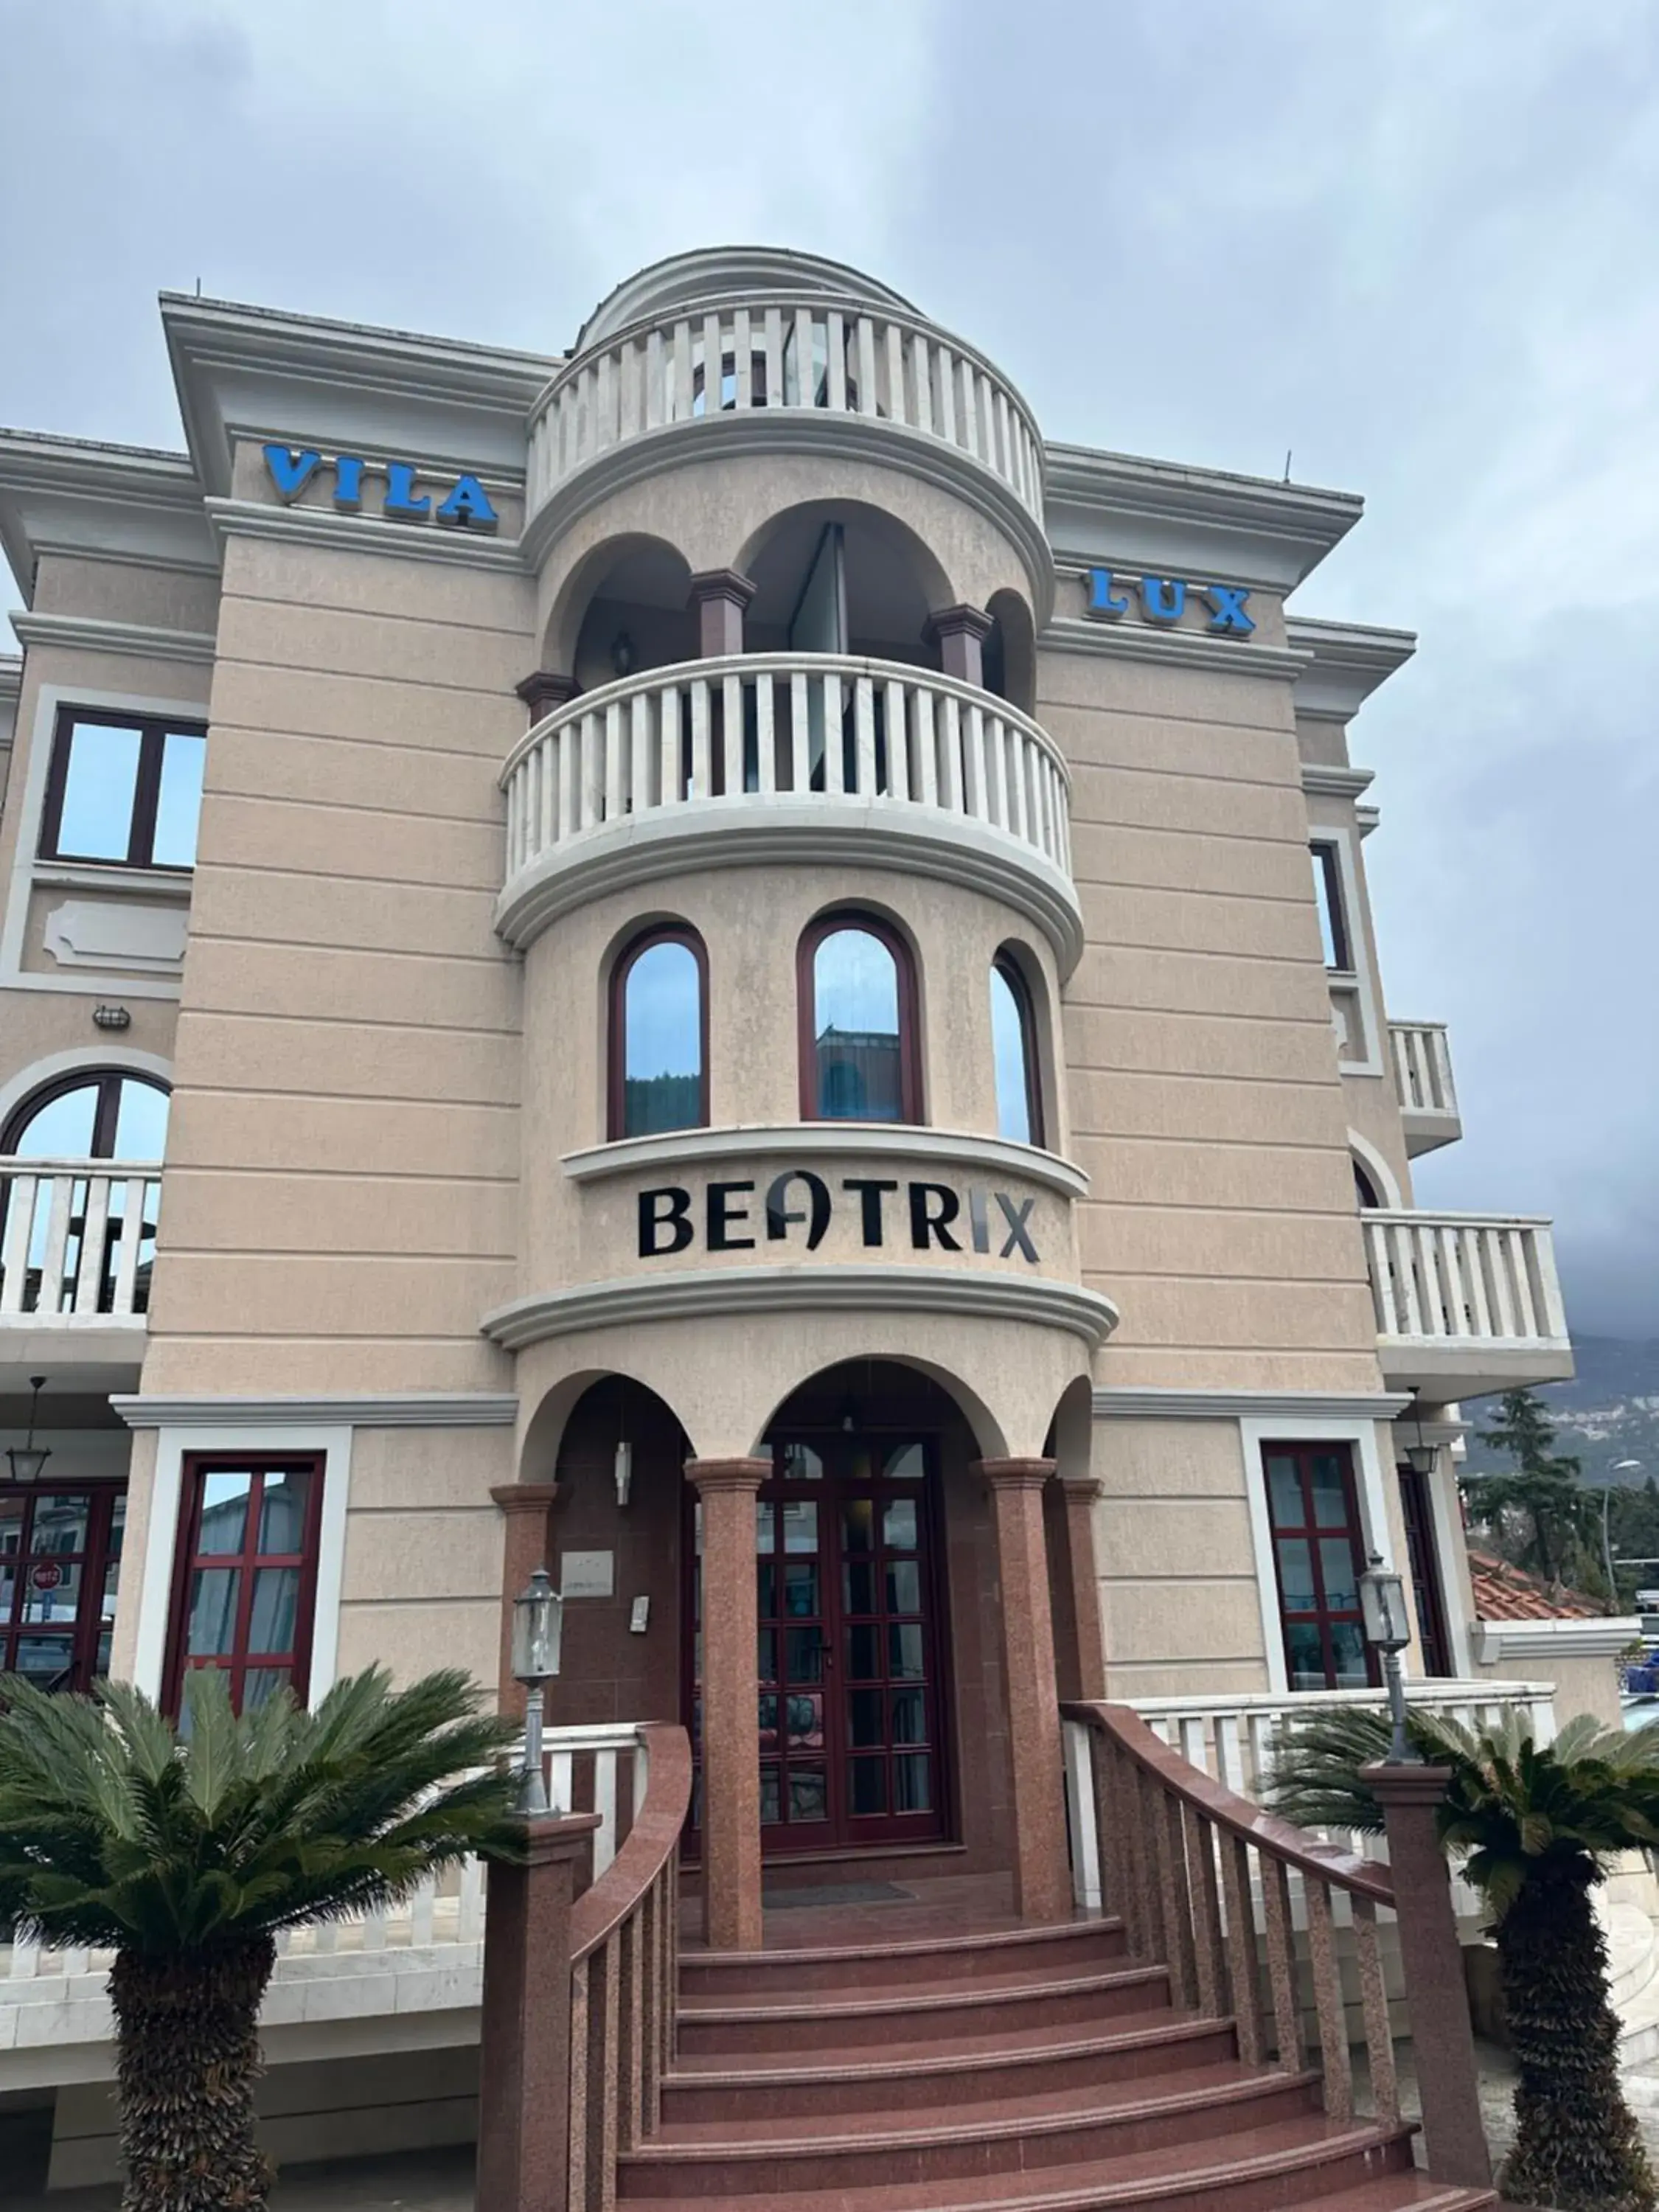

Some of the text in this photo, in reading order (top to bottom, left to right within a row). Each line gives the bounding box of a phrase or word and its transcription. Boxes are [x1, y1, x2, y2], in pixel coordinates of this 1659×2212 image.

[263, 445, 498, 532] VILA
[1088, 568, 1256, 636] LUX
[638, 1169, 1040, 1263] BEATRIX
